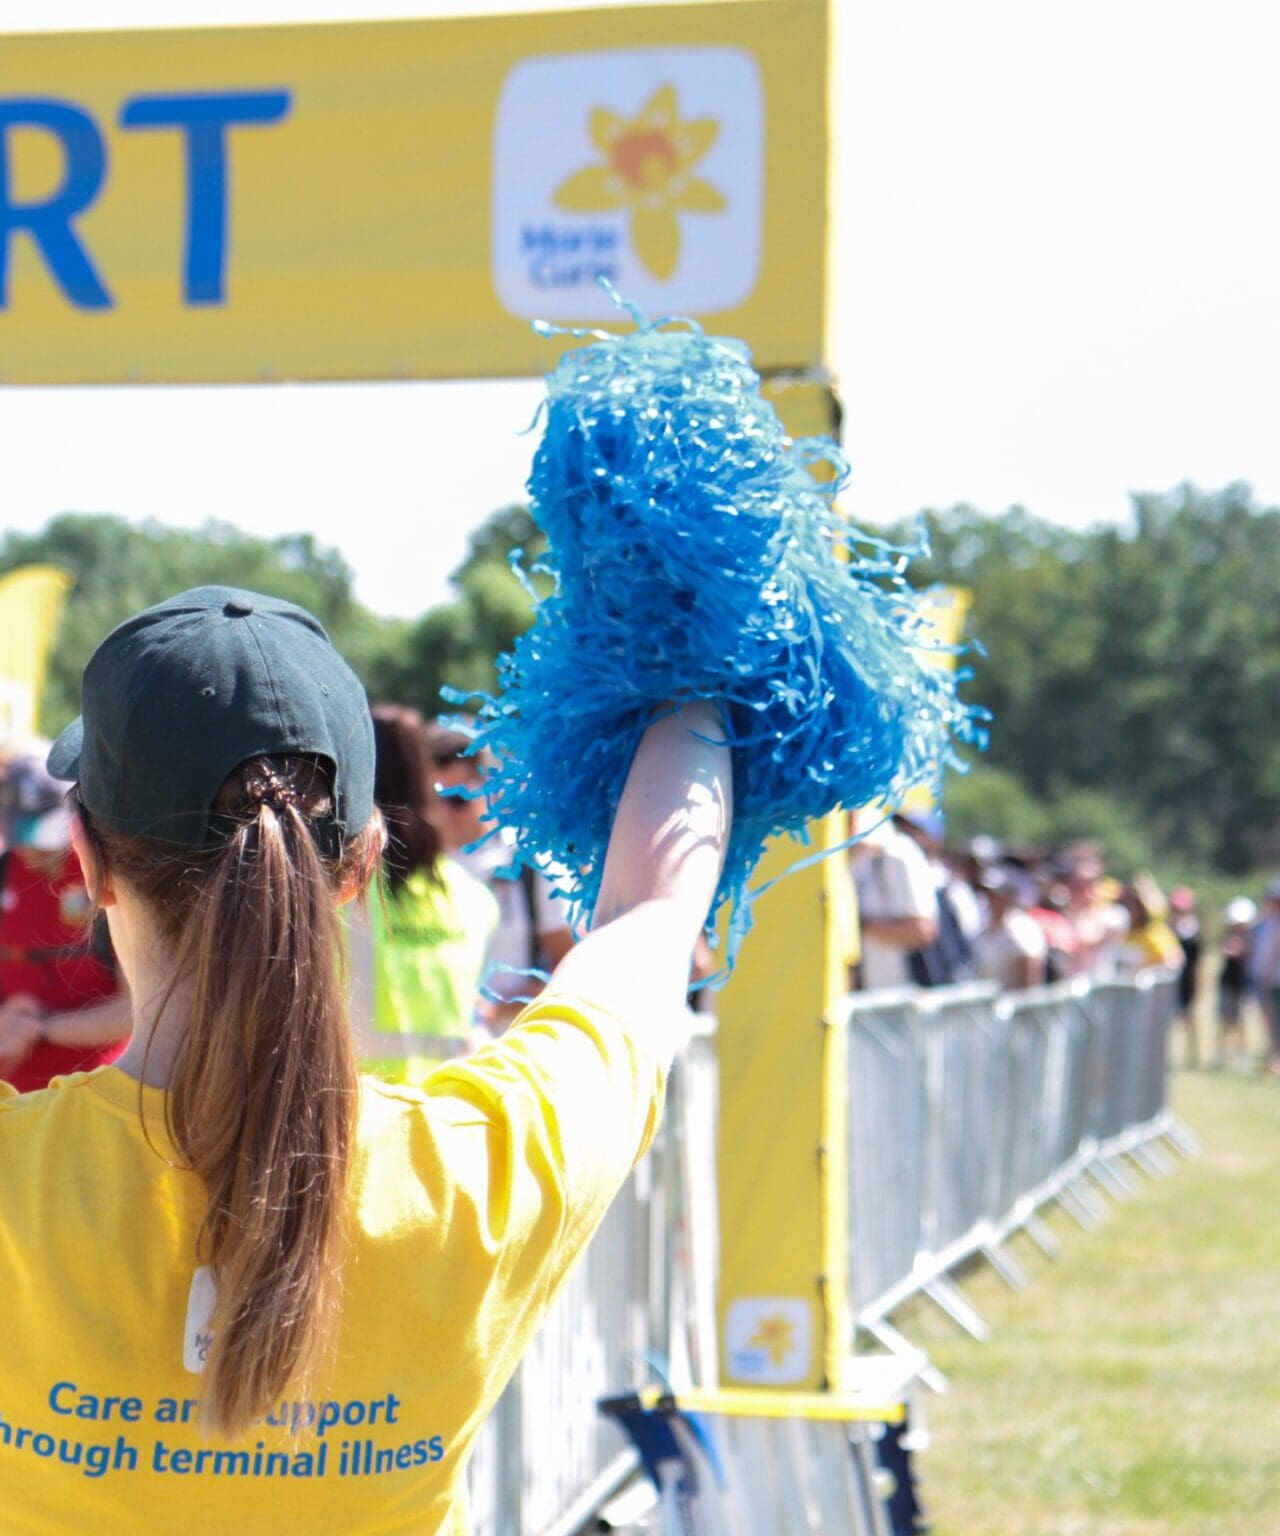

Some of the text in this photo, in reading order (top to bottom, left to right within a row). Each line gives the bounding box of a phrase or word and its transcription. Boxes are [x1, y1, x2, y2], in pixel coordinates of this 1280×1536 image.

[48, 1381, 143, 1423] Care
[263, 1393, 402, 1437] upport
[152, 1441, 329, 1477] terminal
[339, 1435, 446, 1476] illness
